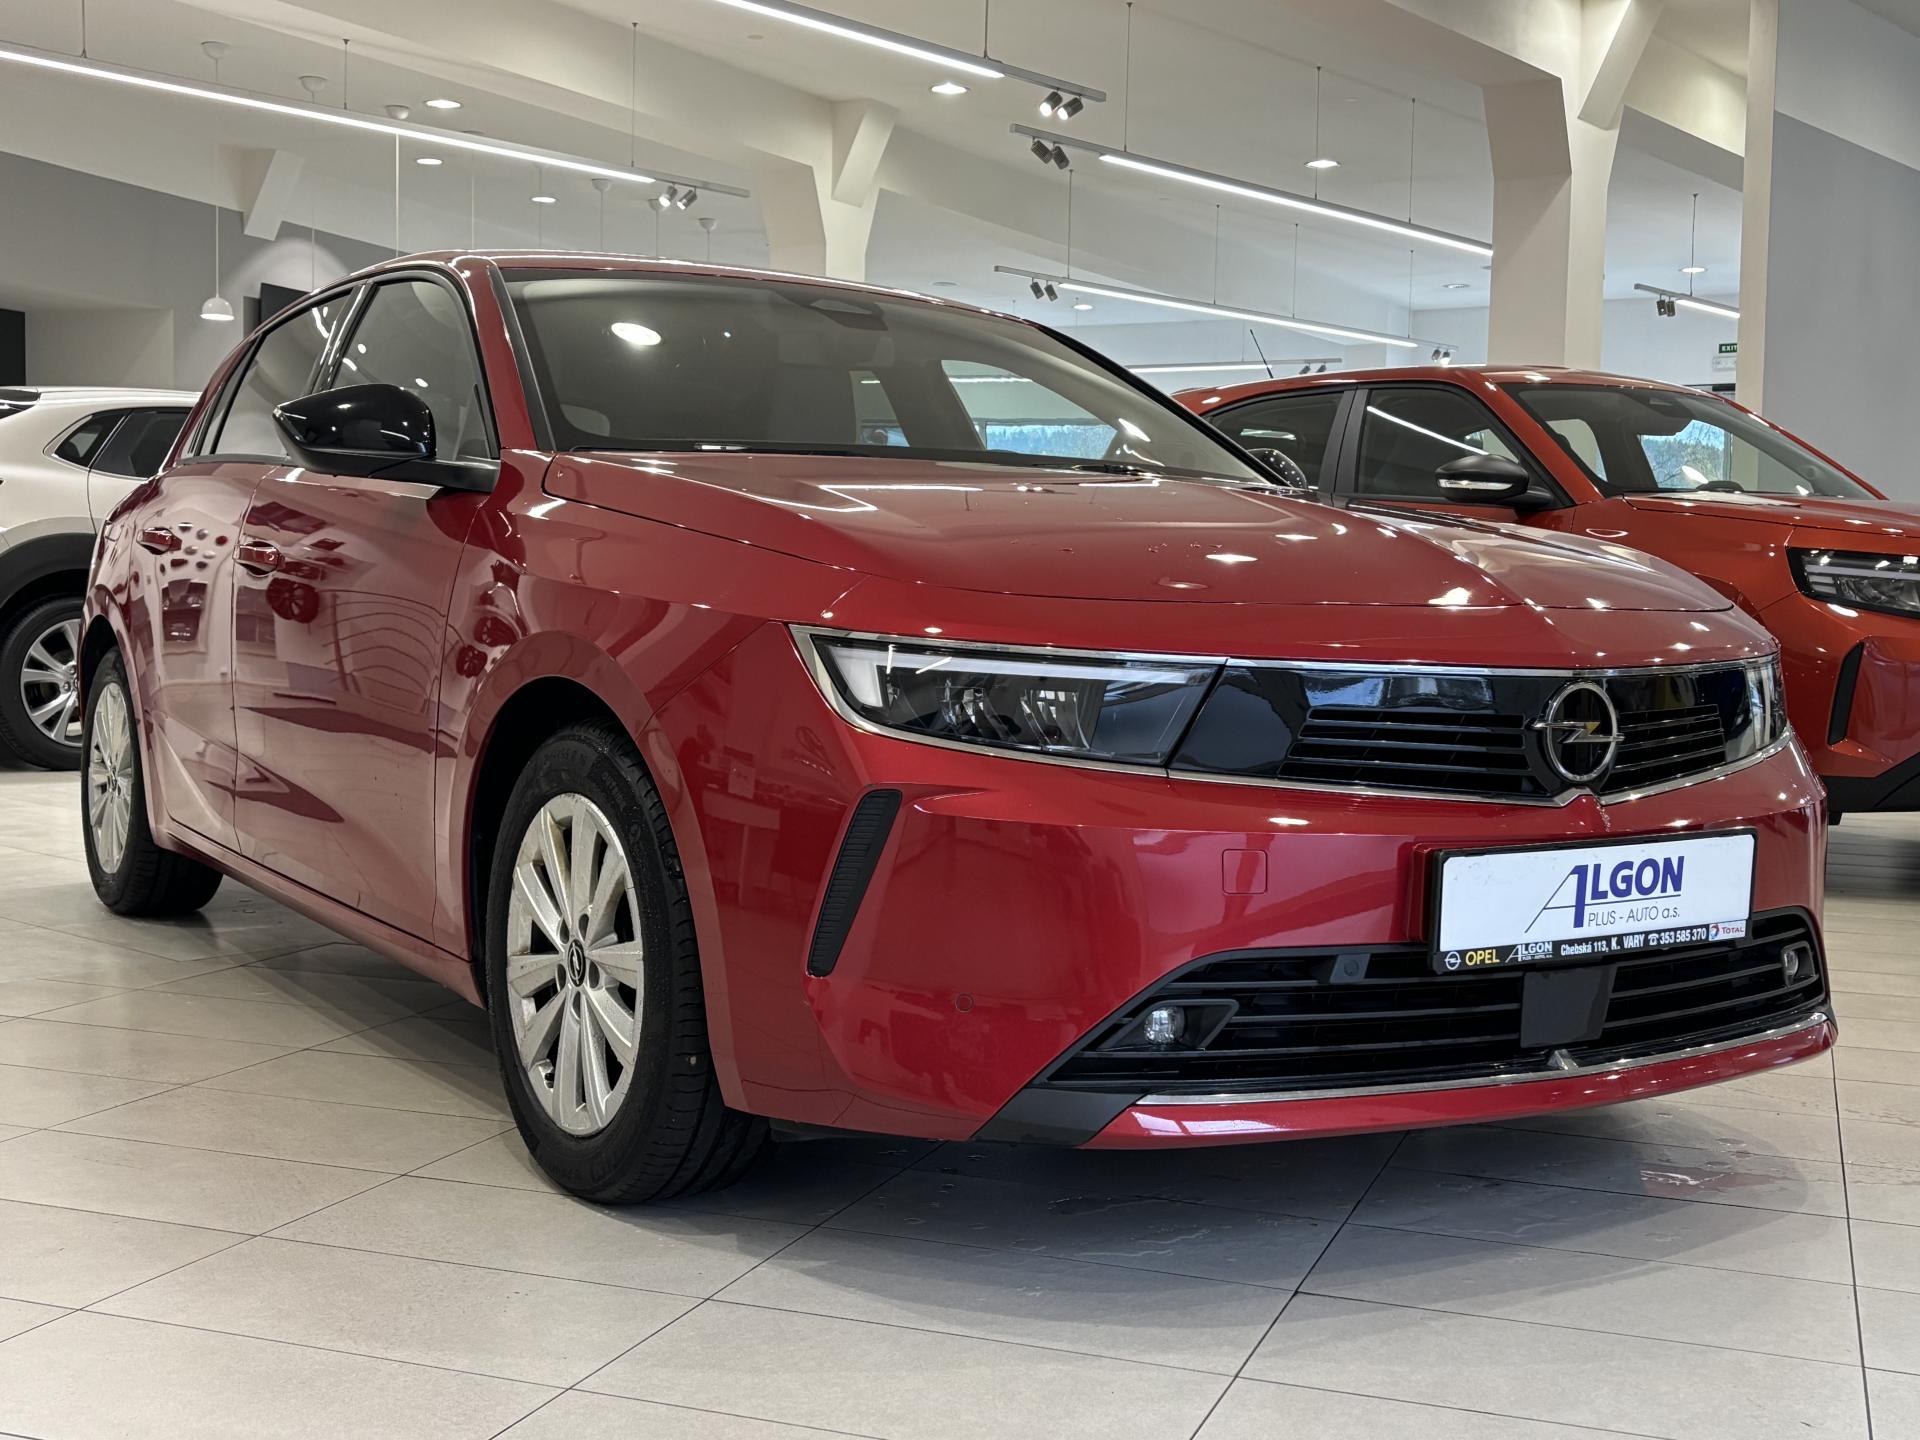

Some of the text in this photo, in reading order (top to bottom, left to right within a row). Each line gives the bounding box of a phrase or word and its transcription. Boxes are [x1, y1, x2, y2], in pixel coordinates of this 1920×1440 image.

[1524, 855, 1685, 933] ALGON
[1588, 910, 1616, 927] PLUS
[1626, 906, 1659, 923] AUTO
[1662, 906, 1680, 919] a.s.
[1721, 925, 1745, 935] TOTAL
[1505, 941, 1553, 963] ALGON
[1561, 927, 1707, 956] Chebská 113, K. VARY 353 585 370
[1465, 949, 1500, 966] OPEL
